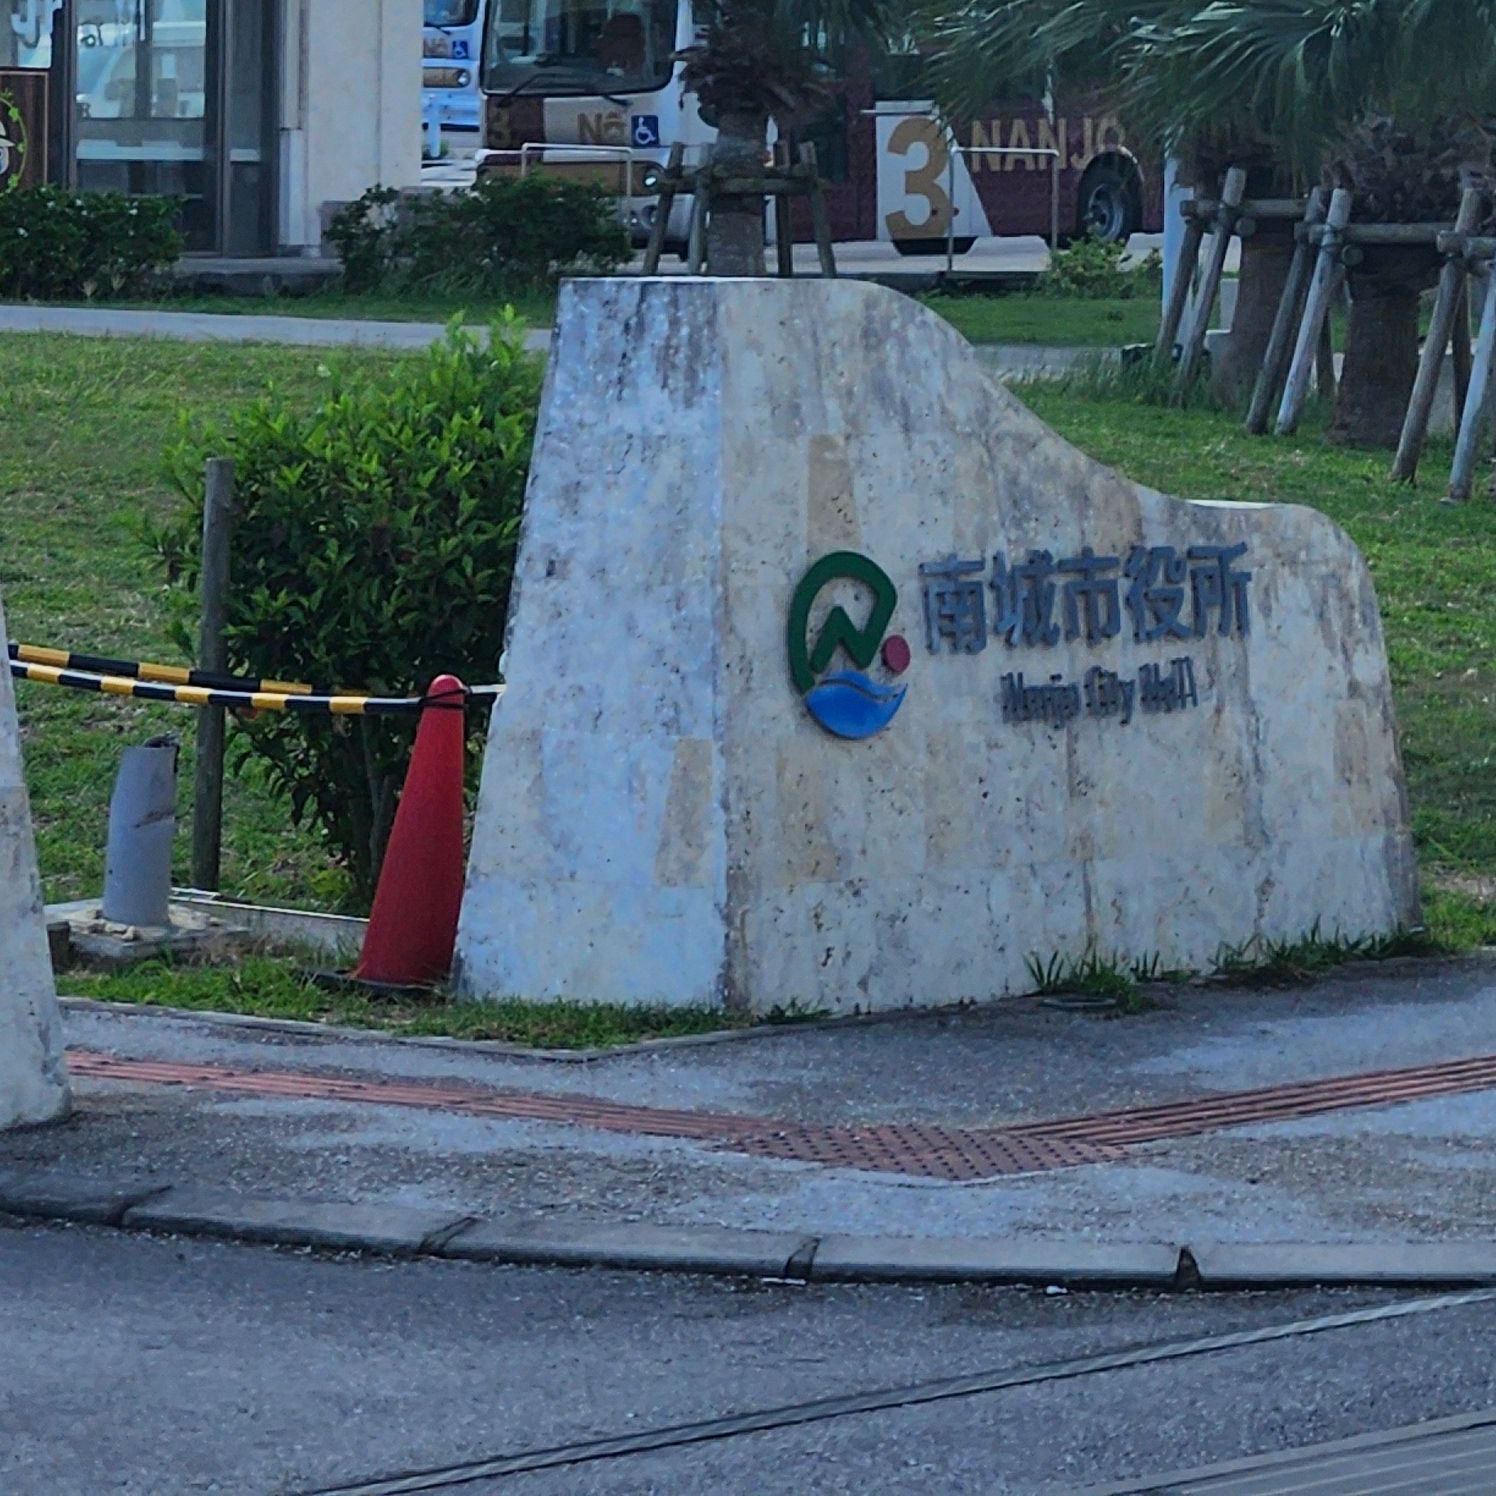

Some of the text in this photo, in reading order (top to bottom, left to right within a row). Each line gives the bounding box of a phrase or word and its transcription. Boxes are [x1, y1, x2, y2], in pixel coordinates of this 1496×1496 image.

[885, 117, 949, 238] 3
[918, 541, 1252, 655] 南城市役所
[1084, 665, 1136, 726] City
[1139, 656, 1199, 713] Hall
